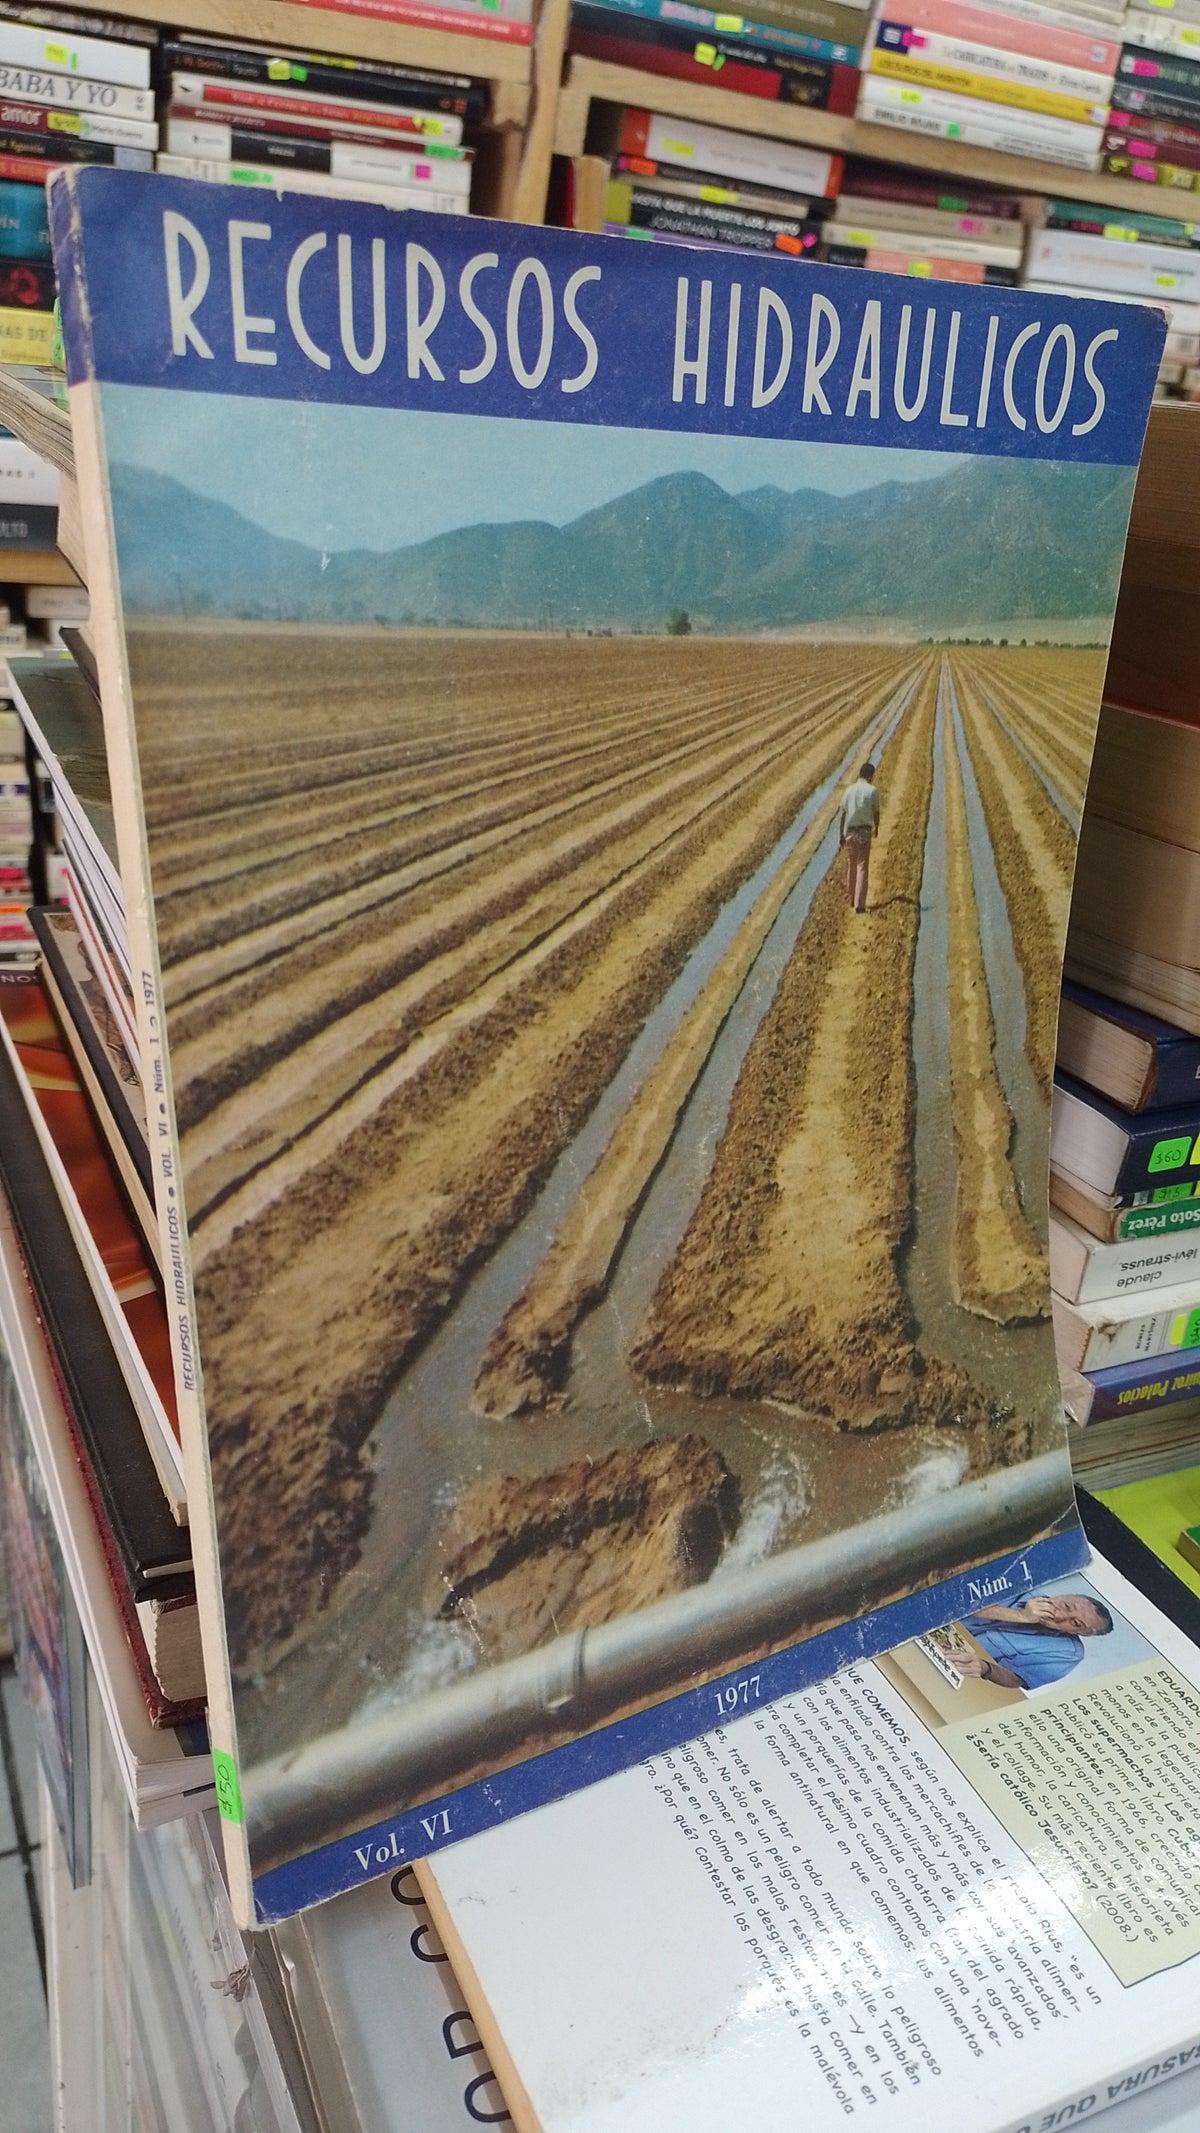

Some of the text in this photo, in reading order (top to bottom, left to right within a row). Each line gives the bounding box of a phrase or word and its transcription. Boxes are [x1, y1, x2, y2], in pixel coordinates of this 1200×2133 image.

[1, 106, 42, 125] amor
[66, 81, 82, 99] Y
[86, 85, 117, 107] YO
[650, 215, 719, 238] JONATHAN
[163, 211, 1119, 436] RECURSOS HIDRAULICOS
[142, 970, 154, 1006] 1977
[159, 1122, 168, 1136] VI
[1116, 1271, 1162, 1288] claude
[1128, 1215, 1166, 1230] Pérez
[1117, 1380, 1169, 1405] Palacios
[967, 1560, 1032, 1604] Núm. 1
[714, 1675, 760, 1715] 1977
[1086, 1693, 1143, 1750] Revolucionó
[1100, 1689, 1130, 1718] monos
[1124, 1694, 1144, 1712] raíz
[1129, 1680, 1187, 1738] convirtiendo
[1156, 1689, 1194, 1729] Zamora,
[217, 1764, 234, 1814] $50
[822, 1698, 843, 1715] que
[837, 1718, 862, 1741] pasa
[860, 1743, 877, 1761] nos
[875, 1764, 922, 1821] envenenan
[920, 1824, 941, 1847] más
[947, 1862, 970, 1886] más
[997, 1722, 1015, 1737] del
[1014, 1741, 1043, 1777] humor,
[1057, 1794, 1108, 1856] caricatura,
[1013, 1717, 1143, 1870] información conocimientos
[1028, 1714, 1134, 1834] ello una original forma
[1040, 1709, 1104, 1778] principiantes,
[1122, 1798, 1150, 1828] 1966,
[1057, 1703, 1094, 1739] Publicó
[1103, 1758, 1140, 1793] primer
[1139, 1796, 1164, 1825] libro,
[1071, 1698, 1184, 1822] Los supermachos Los
[353, 1810, 454, 1871] Vol. VI
[778, 1723, 818, 1774] completar
[822, 1791, 857, 1829] pésimo
[855, 1832, 888, 1874] cuadro
[886, 1877, 931, 1936] contamos
[948, 1969, 970, 1995] una
[803, 1696, 1042, 2032] con los alimentos industrializados rápida,
[839, 1688, 1082, 2011] enfilado contra los mercachifles alimen-
[860, 1688, 910, 1748] COMEMOS,
[909, 1751, 939, 1783] según
[937, 1787, 956, 1806] nos
[956, 1811, 991, 1852] explica
[1037, 1919, 1063, 1954] Rius,
[965, 1733, 999, 1768] ¿Sería
[999, 1773, 1038, 1816] católico
[1093, 1894, 1139, 1943] (2008.)
[1002, 1752, 1143, 1922] collage. más reciente libro
[669, 1772, 690, 1792] que
[707, 1829, 733, 1862] colmo
[742, 1885, 758, 1904] las
[829, 2030, 862, 2079] comer
[707, 1789, 734, 1824] comer
[746, 1851, 762, 1868] los
[761, 1875, 788, 1911] malos
[880, 2071, 899, 2094] los
[728, 1748, 942, 2075] trata alertar todo mundo sobre peligroso
[728, 1785, 748, 1807] sólo
[765, 1847, 800, 1890] peligro
[798, 1894, 829, 1935] comer
[851, 1979, 878, 2017] calle.
[877, 2020, 921, 2084] También
[764, 1735, 790, 1766] forma
[789, 1772, 839, 1833] antinatural
[846, 1861, 870, 1883] que
[869, 1889, 914, 1951] comemos:
[933, 1986, 984, 2057] alimentos
[801, 1729, 849, 1785] porquerías
[871, 1822, 905, 1863] comida
[904, 1868, 946, 1923] chatarra
[966, 1958, 988, 1980] del
[985, 1987, 1025, 2038] agrado
[652, 1783, 676, 1809] ¿Por
[671, 1814, 698, 1841] qué?
[694, 1846, 735, 1907] Contestar
[733, 1912, 749, 1931] los
[810, 2045, 855, 2114] malévola
[1040, 2094, 1097, 2132] QUE
